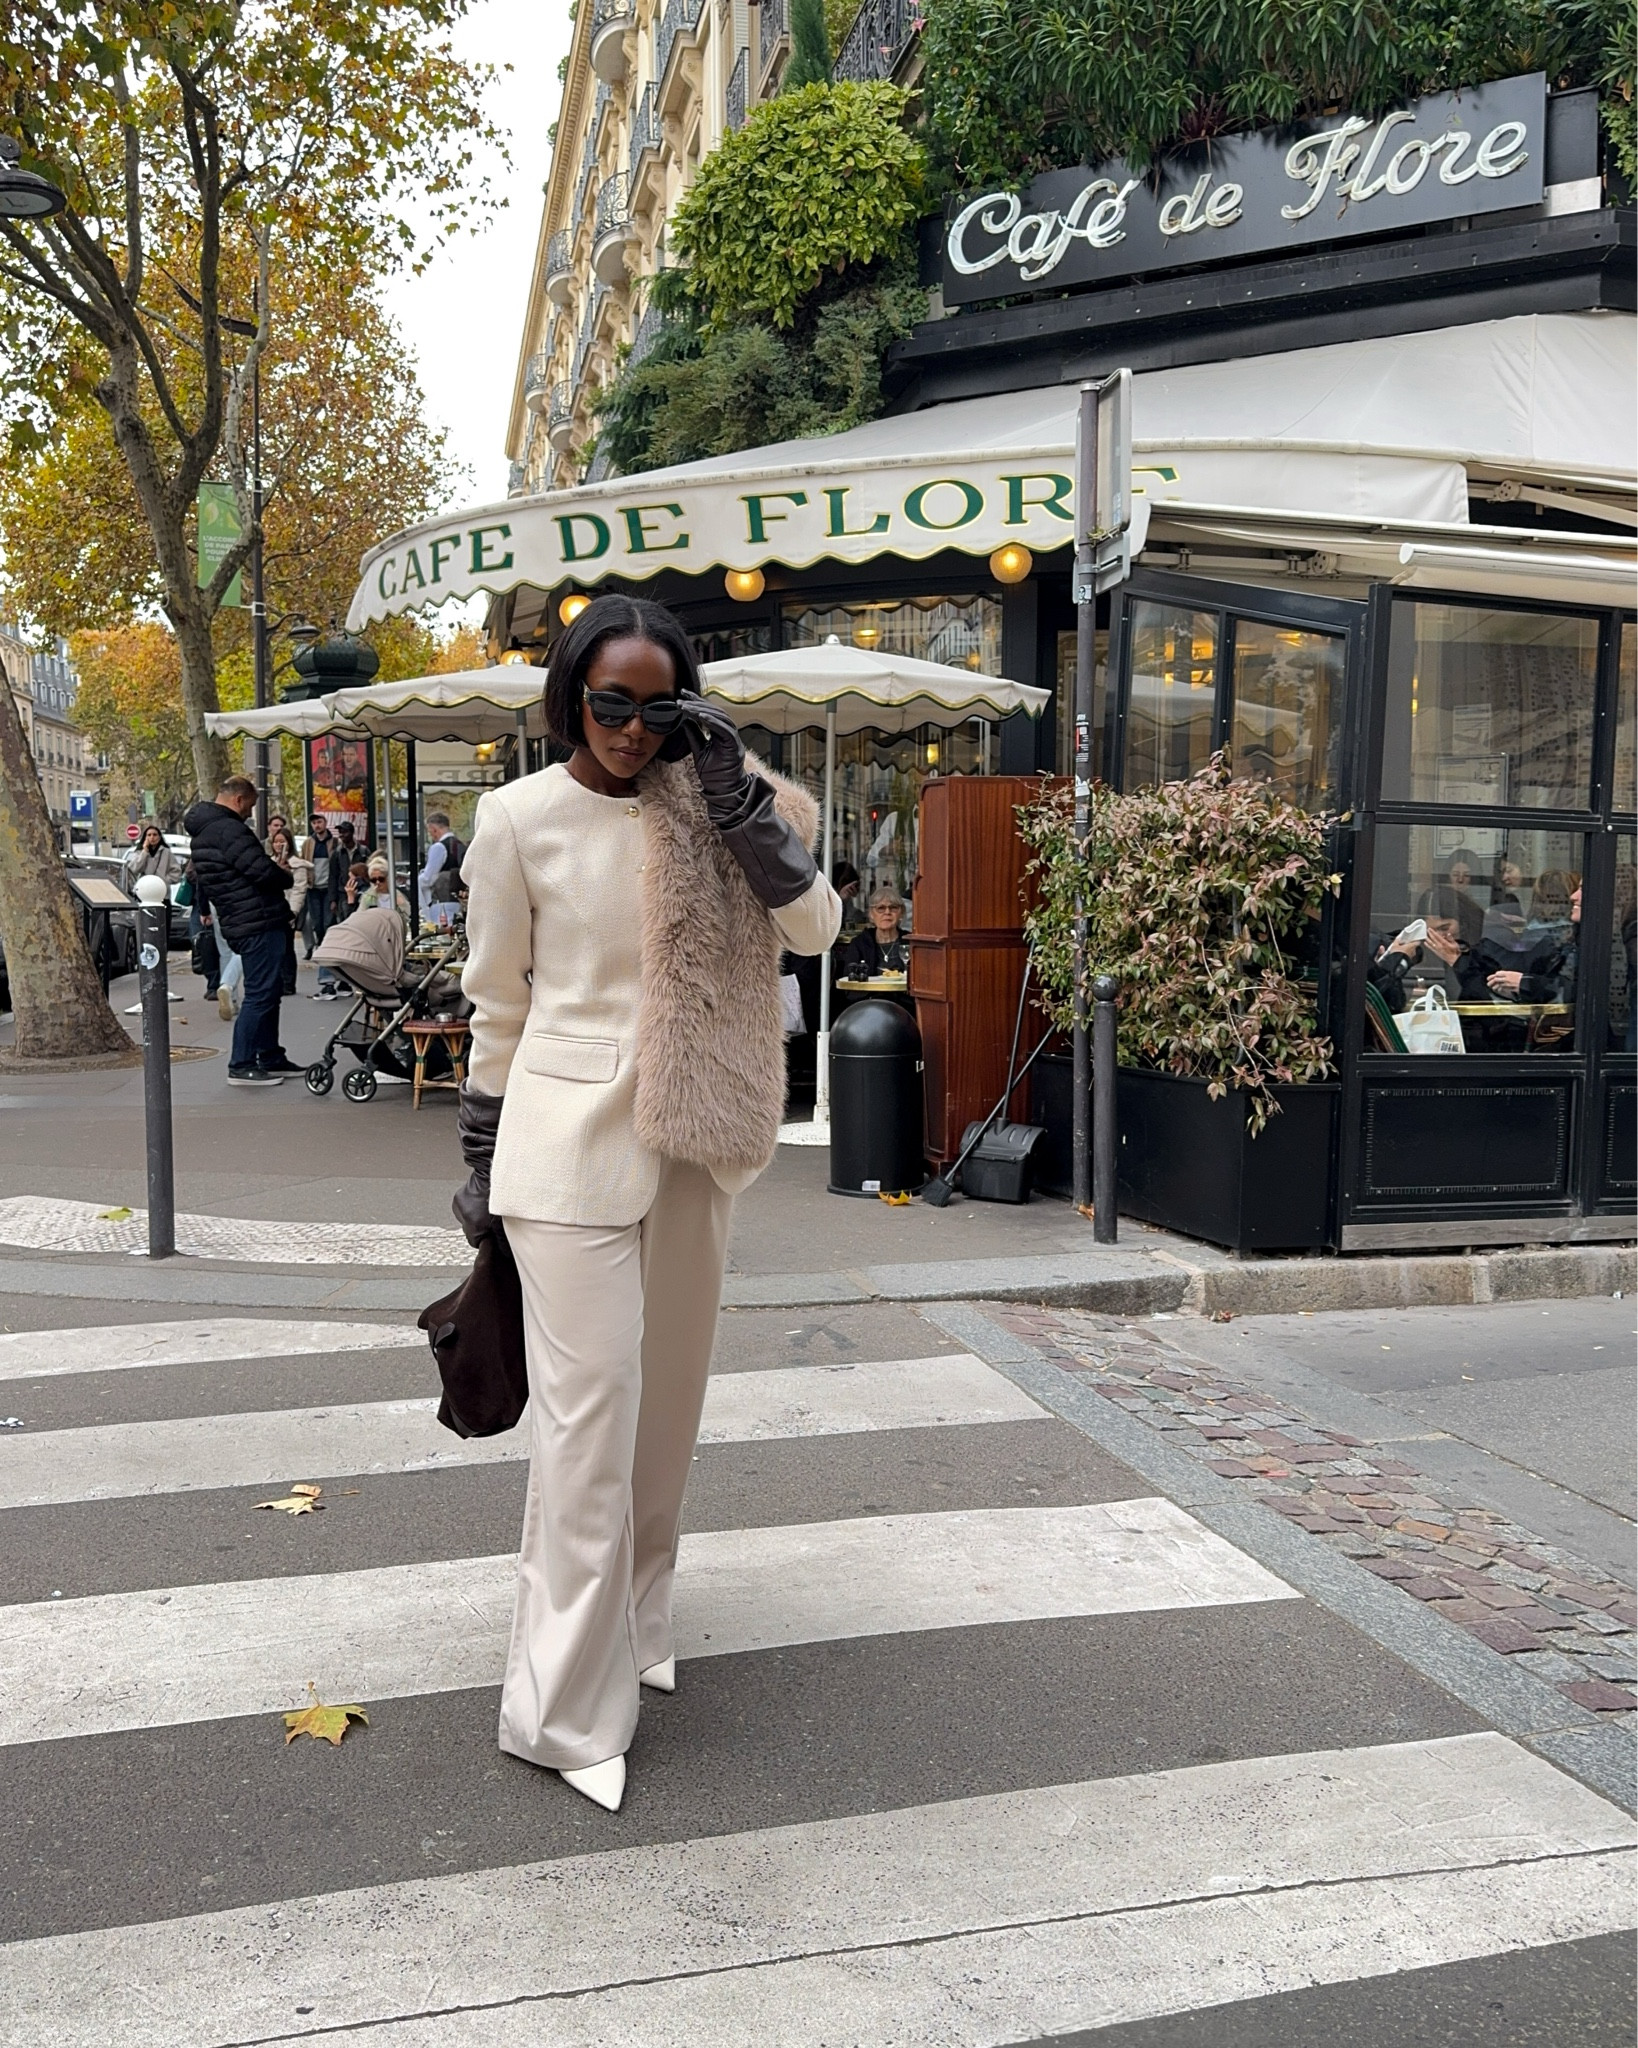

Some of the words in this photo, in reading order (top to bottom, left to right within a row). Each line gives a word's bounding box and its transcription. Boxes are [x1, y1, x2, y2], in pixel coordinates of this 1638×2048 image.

[948, 178, 1140, 281] Café
[1159, 173, 1243, 235] de
[1281, 111, 1529, 219] Flore
[378, 523, 515, 601] CAFE
[550, 503, 693, 564] DE
[75, 797, 87, 811] P
